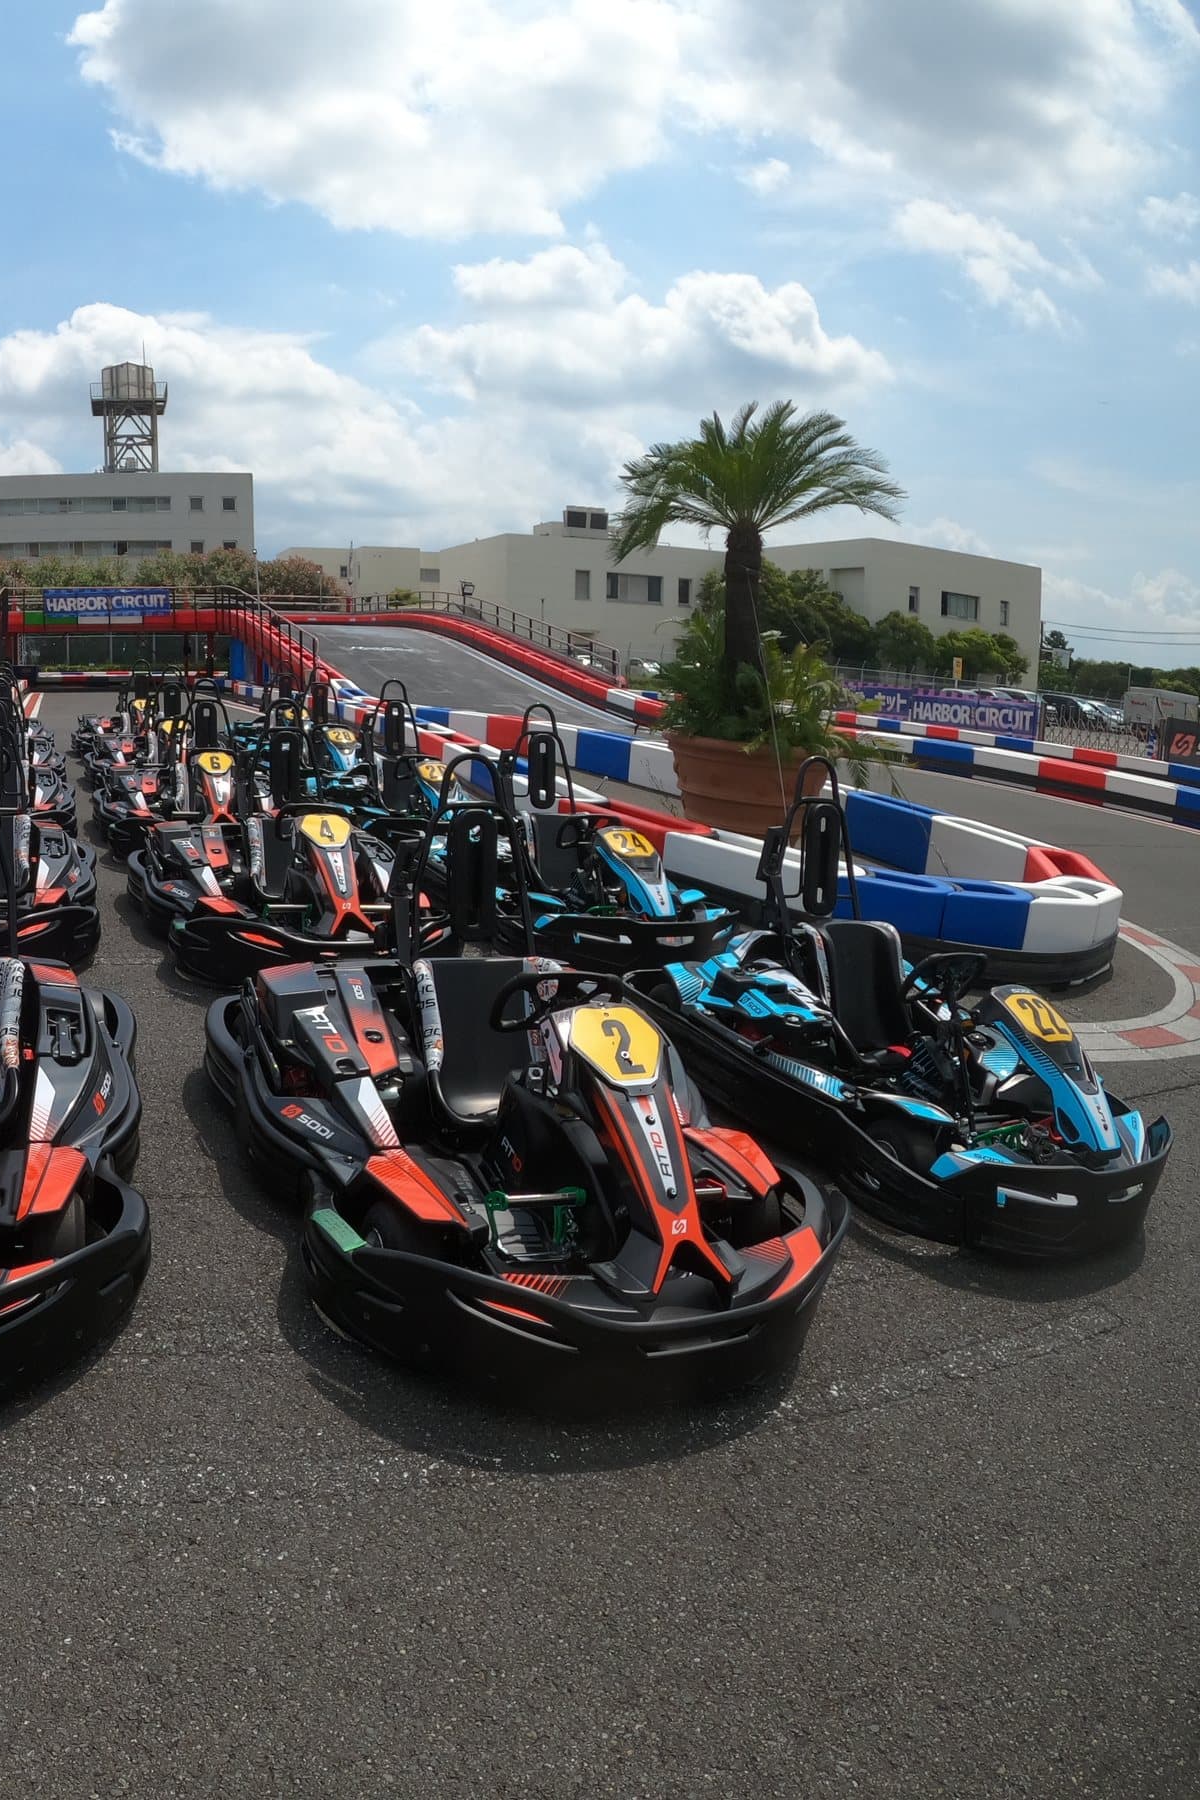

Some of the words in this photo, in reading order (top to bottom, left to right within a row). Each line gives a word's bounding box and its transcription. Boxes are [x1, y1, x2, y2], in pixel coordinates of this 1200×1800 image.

[46, 596, 107, 612] HARBOR
[112, 594, 166, 609] CIRCUIT
[913, 701, 970, 725] HARBOR
[975, 706, 1034, 731] CIRCUIT
[333, 729, 352, 741] 28
[209, 755, 222, 770] 6
[320, 819, 335, 842] 4
[612, 832, 650, 854] 24
[1016, 997, 1071, 1037] 22
[310, 1011, 349, 1054] RT10
[601, 1019, 647, 1074] 2
[100, 1071, 112, 1100] SODI
[297, 1113, 335, 1140] SODI
[650, 1131, 673, 1178] RT10
